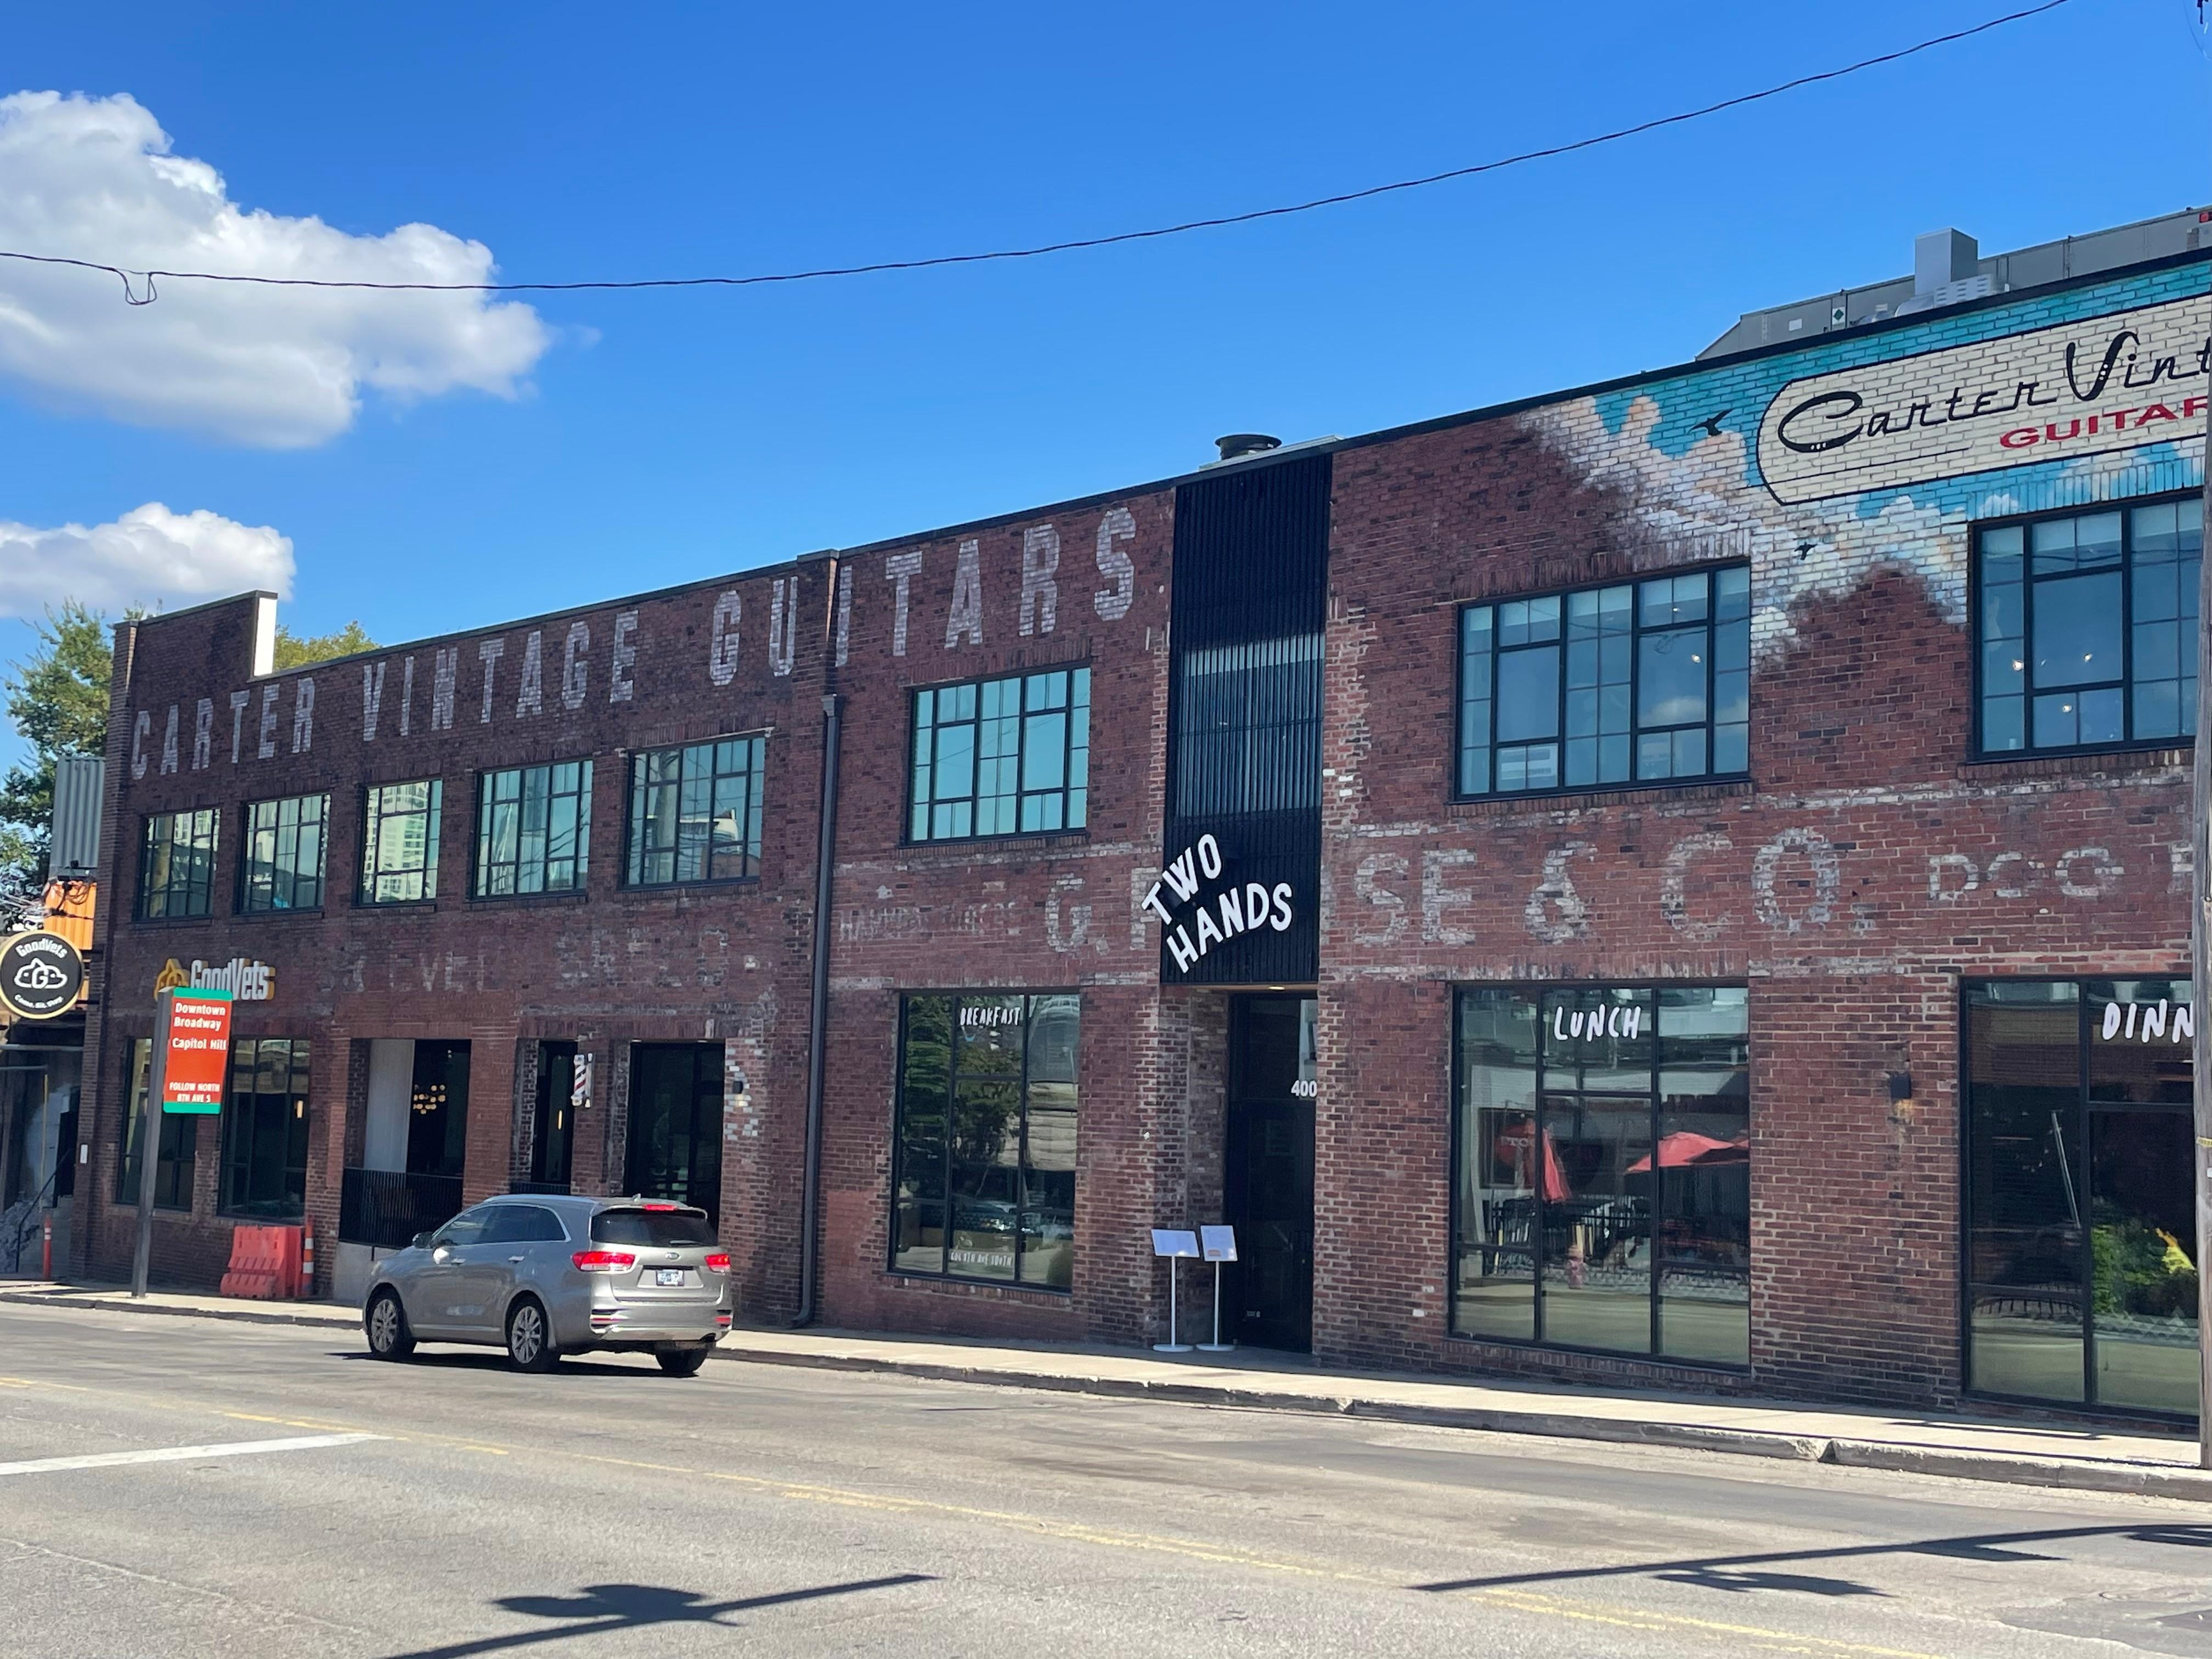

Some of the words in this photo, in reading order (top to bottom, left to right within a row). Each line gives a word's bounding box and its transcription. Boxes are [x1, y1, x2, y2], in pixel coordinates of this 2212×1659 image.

[1779, 382, 2057, 453] Carter
[2067, 331, 2211, 401] Vint
[2000, 396, 2208, 448] GUITAR
[131, 677, 316, 780] CARTER
[363, 610, 639, 741] VINTAGE
[710, 507, 1136, 686] GUITARS
[1141, 834, 1221, 925] TWO
[1166, 883, 1292, 973] HANDS
[15, 938, 68, 958] GoodVets
[191, 958, 270, 1000] GoodVets
[175, 1002, 226, 1015] Downtown
[960, 1006, 1021, 1028] BREAKFAST
[1554, 1004, 1641, 1041] LUNCH
[2102, 998, 2194, 1043] DINN
[173, 1017, 222, 1031] Broadway
[172, 1037, 207, 1050] Capitol
[210, 1039, 227, 1051] Hill
[169, 1081, 196, 1091] FOLLOW
[198, 1083, 220, 1092] NORTH
[191, 1093, 205, 1103] AVE
[1291, 1080, 1318, 1097] 400
